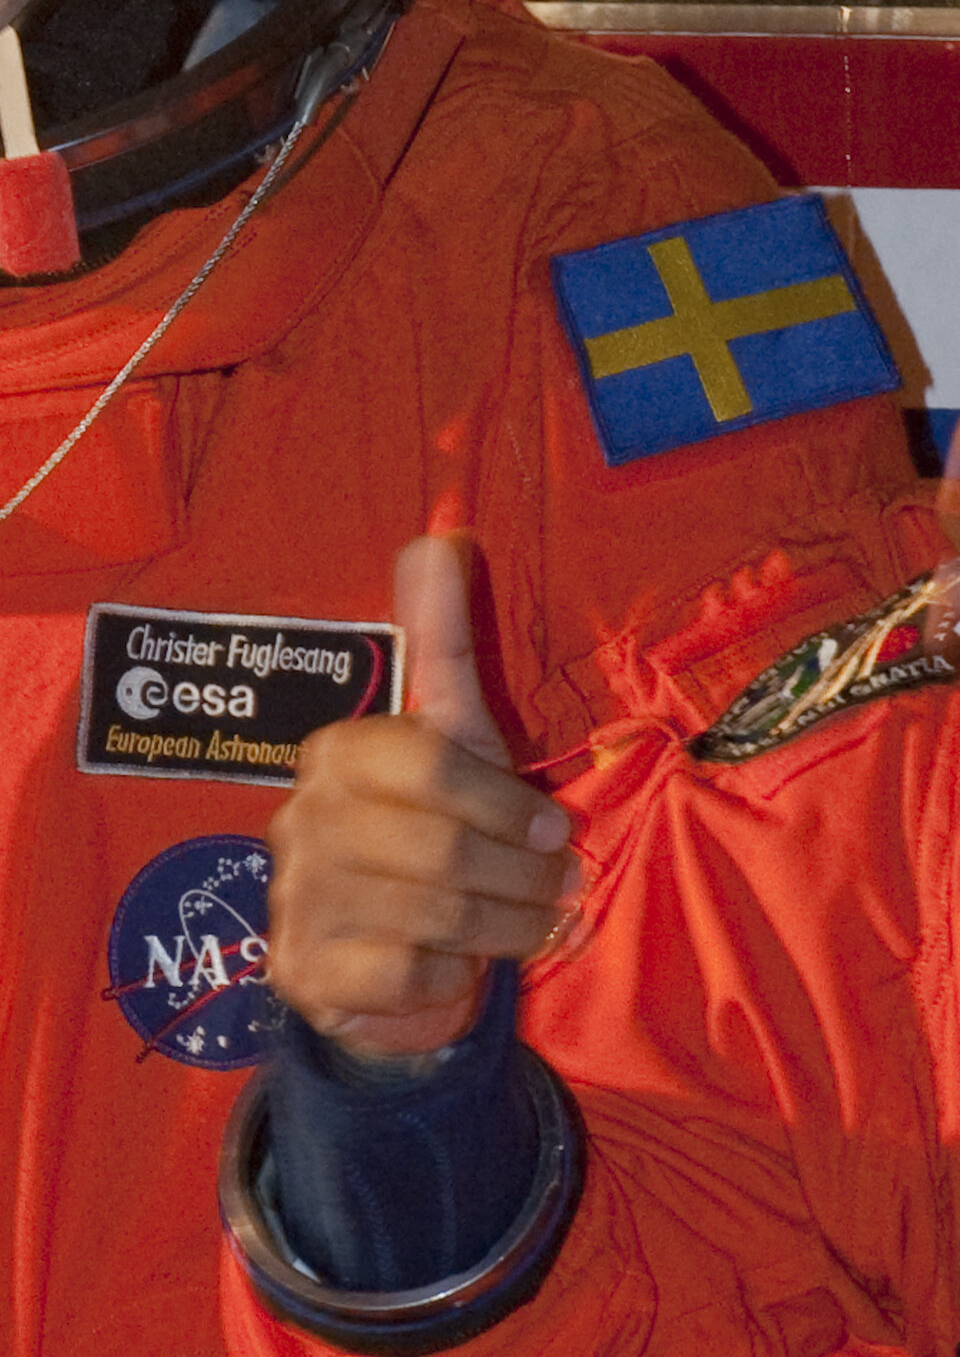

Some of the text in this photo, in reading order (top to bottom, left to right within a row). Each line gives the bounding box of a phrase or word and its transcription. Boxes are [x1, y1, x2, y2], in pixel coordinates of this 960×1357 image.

[126, 623, 353, 684] Christer Fuglesang
[172, 681, 257, 718] esa
[105, 725, 298, 766] European Astronau
[144, 934, 272, 988] NAS
